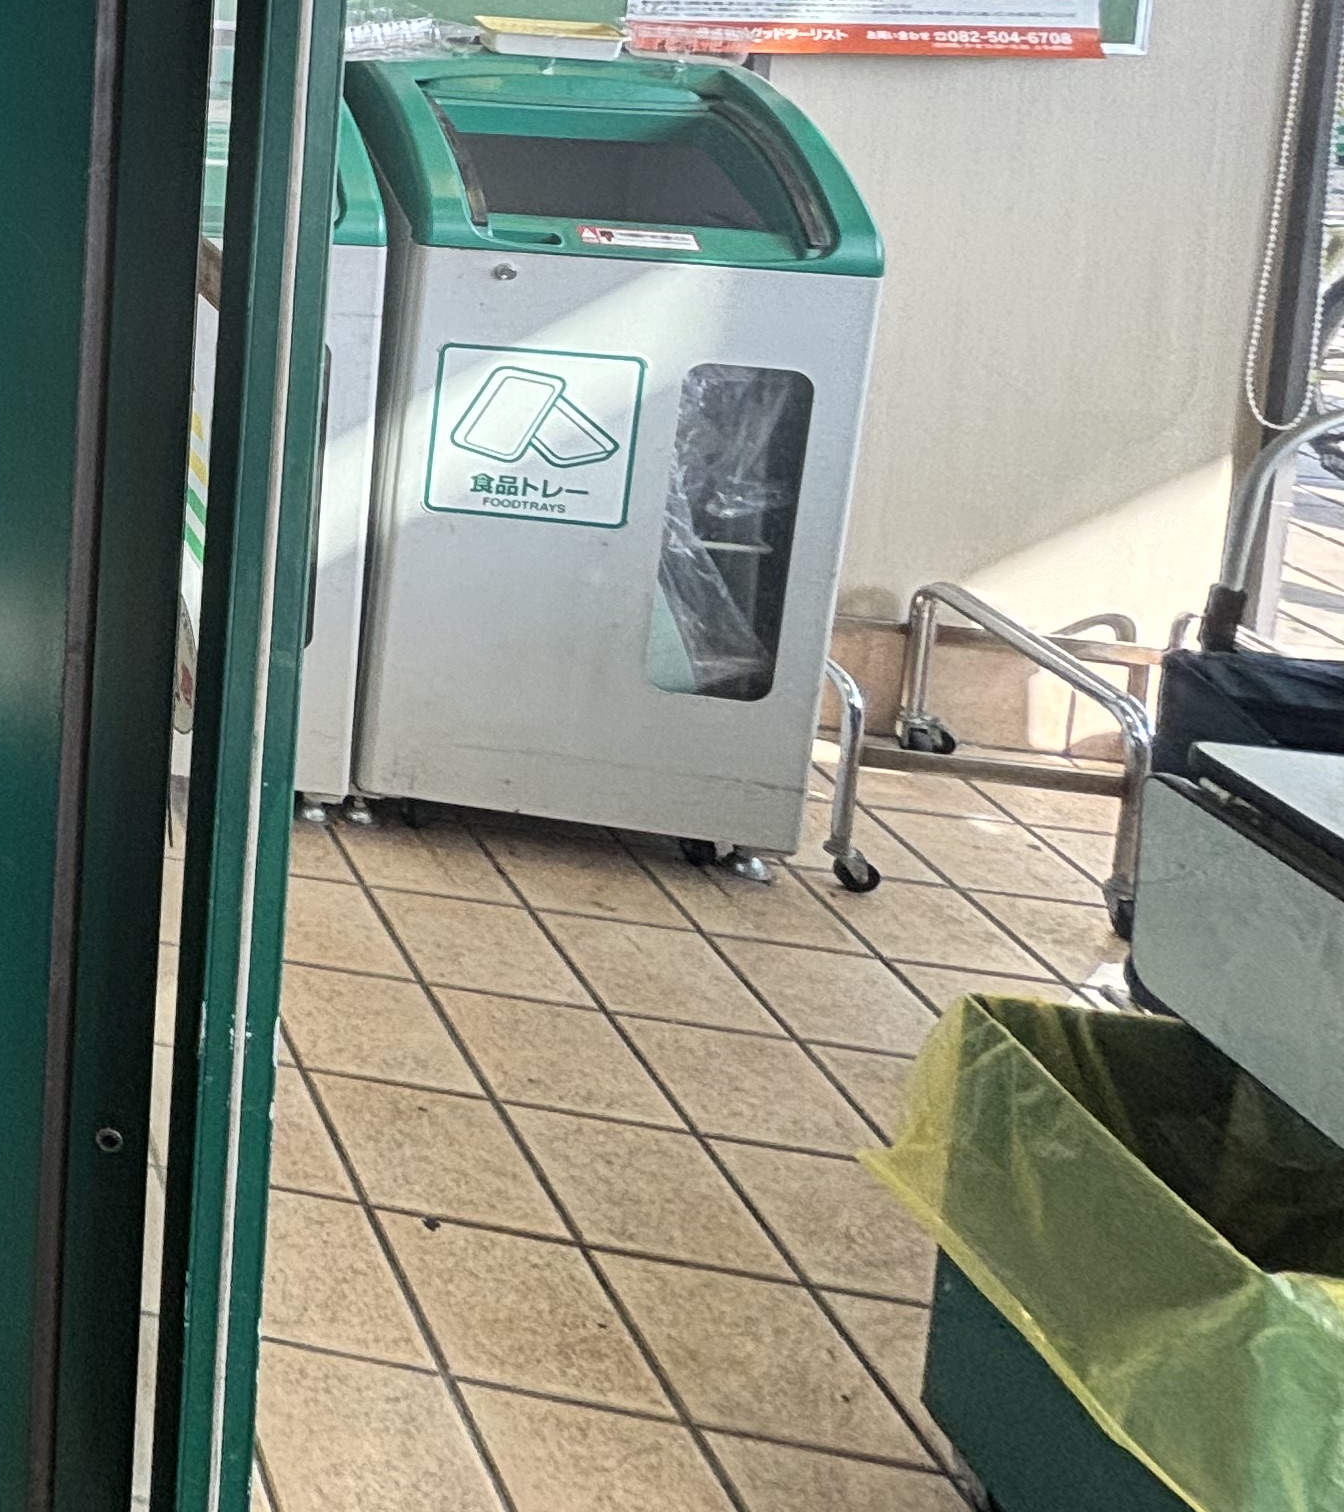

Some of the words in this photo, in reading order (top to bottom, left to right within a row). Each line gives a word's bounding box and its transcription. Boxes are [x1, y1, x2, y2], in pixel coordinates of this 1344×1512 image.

[469, 472, 590, 499] 食品トレー
[482, 495, 566, 514] FOODTRAYS
